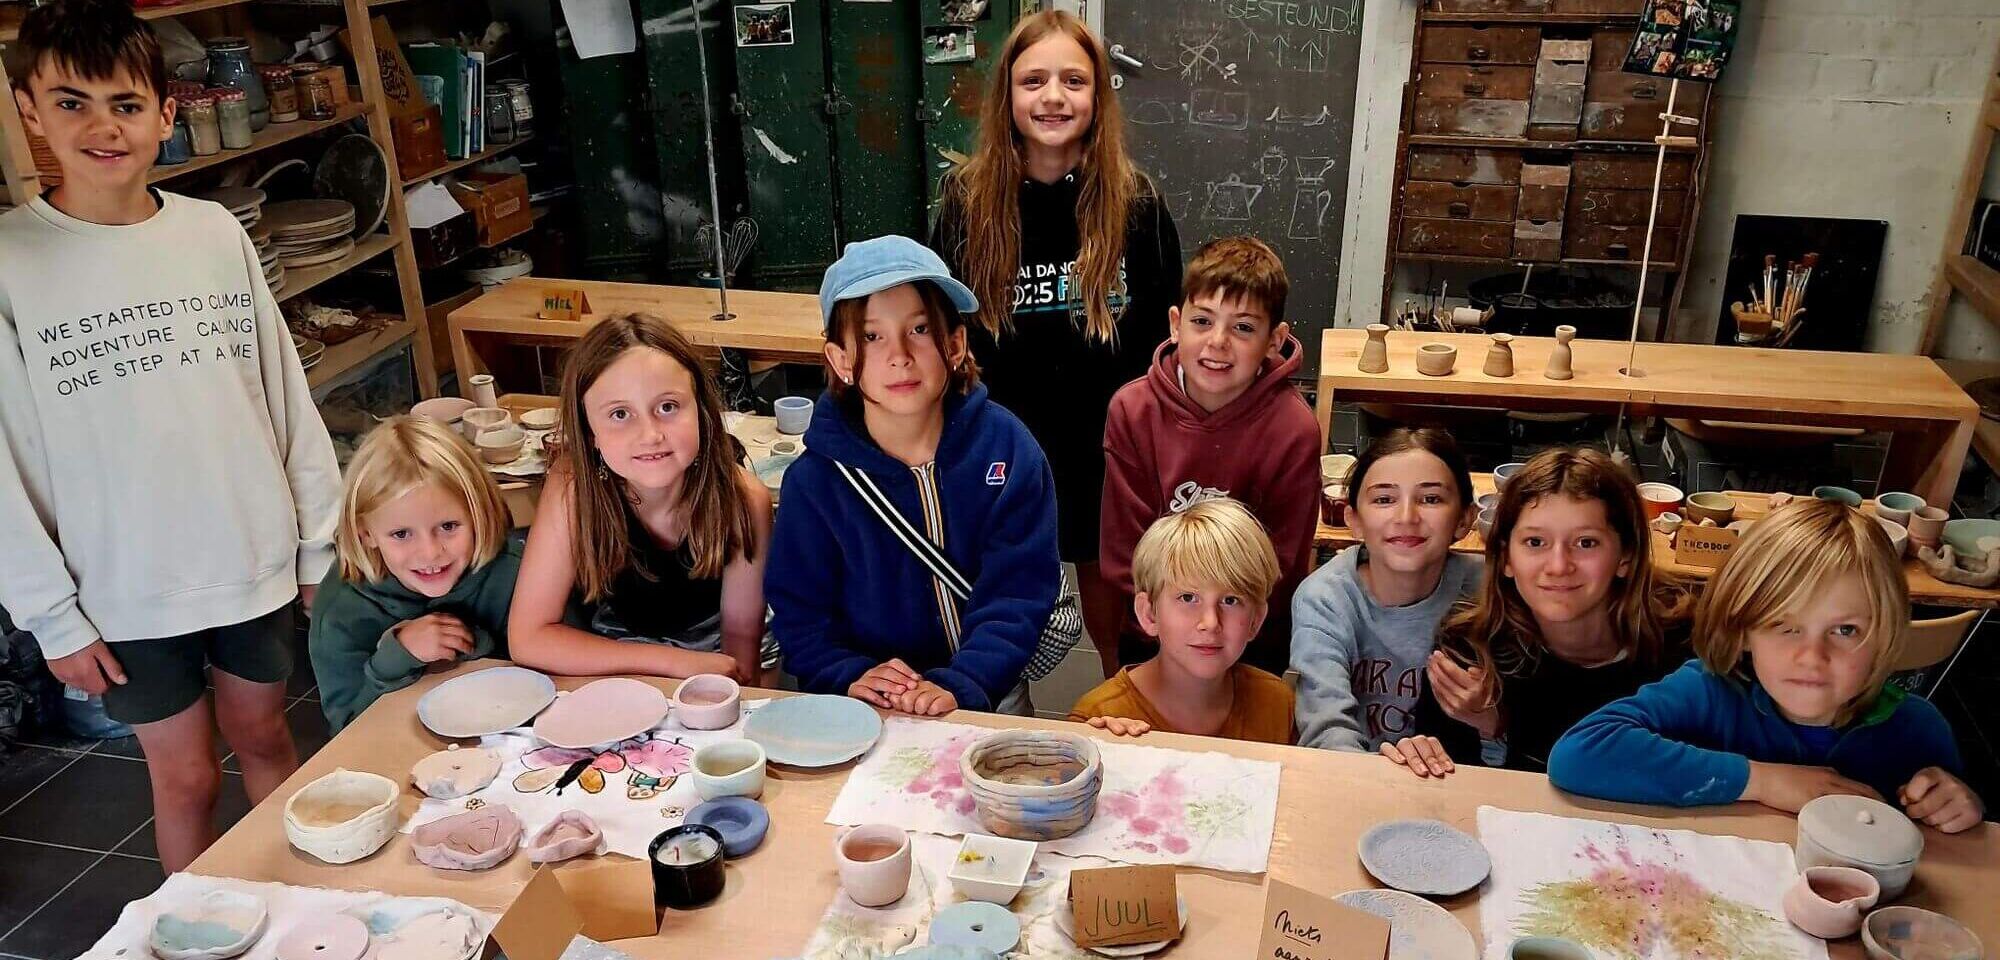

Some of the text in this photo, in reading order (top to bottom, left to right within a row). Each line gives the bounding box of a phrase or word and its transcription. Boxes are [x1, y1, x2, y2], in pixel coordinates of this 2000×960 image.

[37, 323, 73, 344] WE
[79, 301, 173, 333] STARTED
[178, 297, 203, 313] TO
[49, 326, 175, 371] ADVENTURE
[57, 369, 102, 396] ONE
[114, 354, 164, 377] STEP
[180, 349, 201, 366] AT
[216, 346, 227, 361] A
[1084, 895, 1163, 937] JUUL
